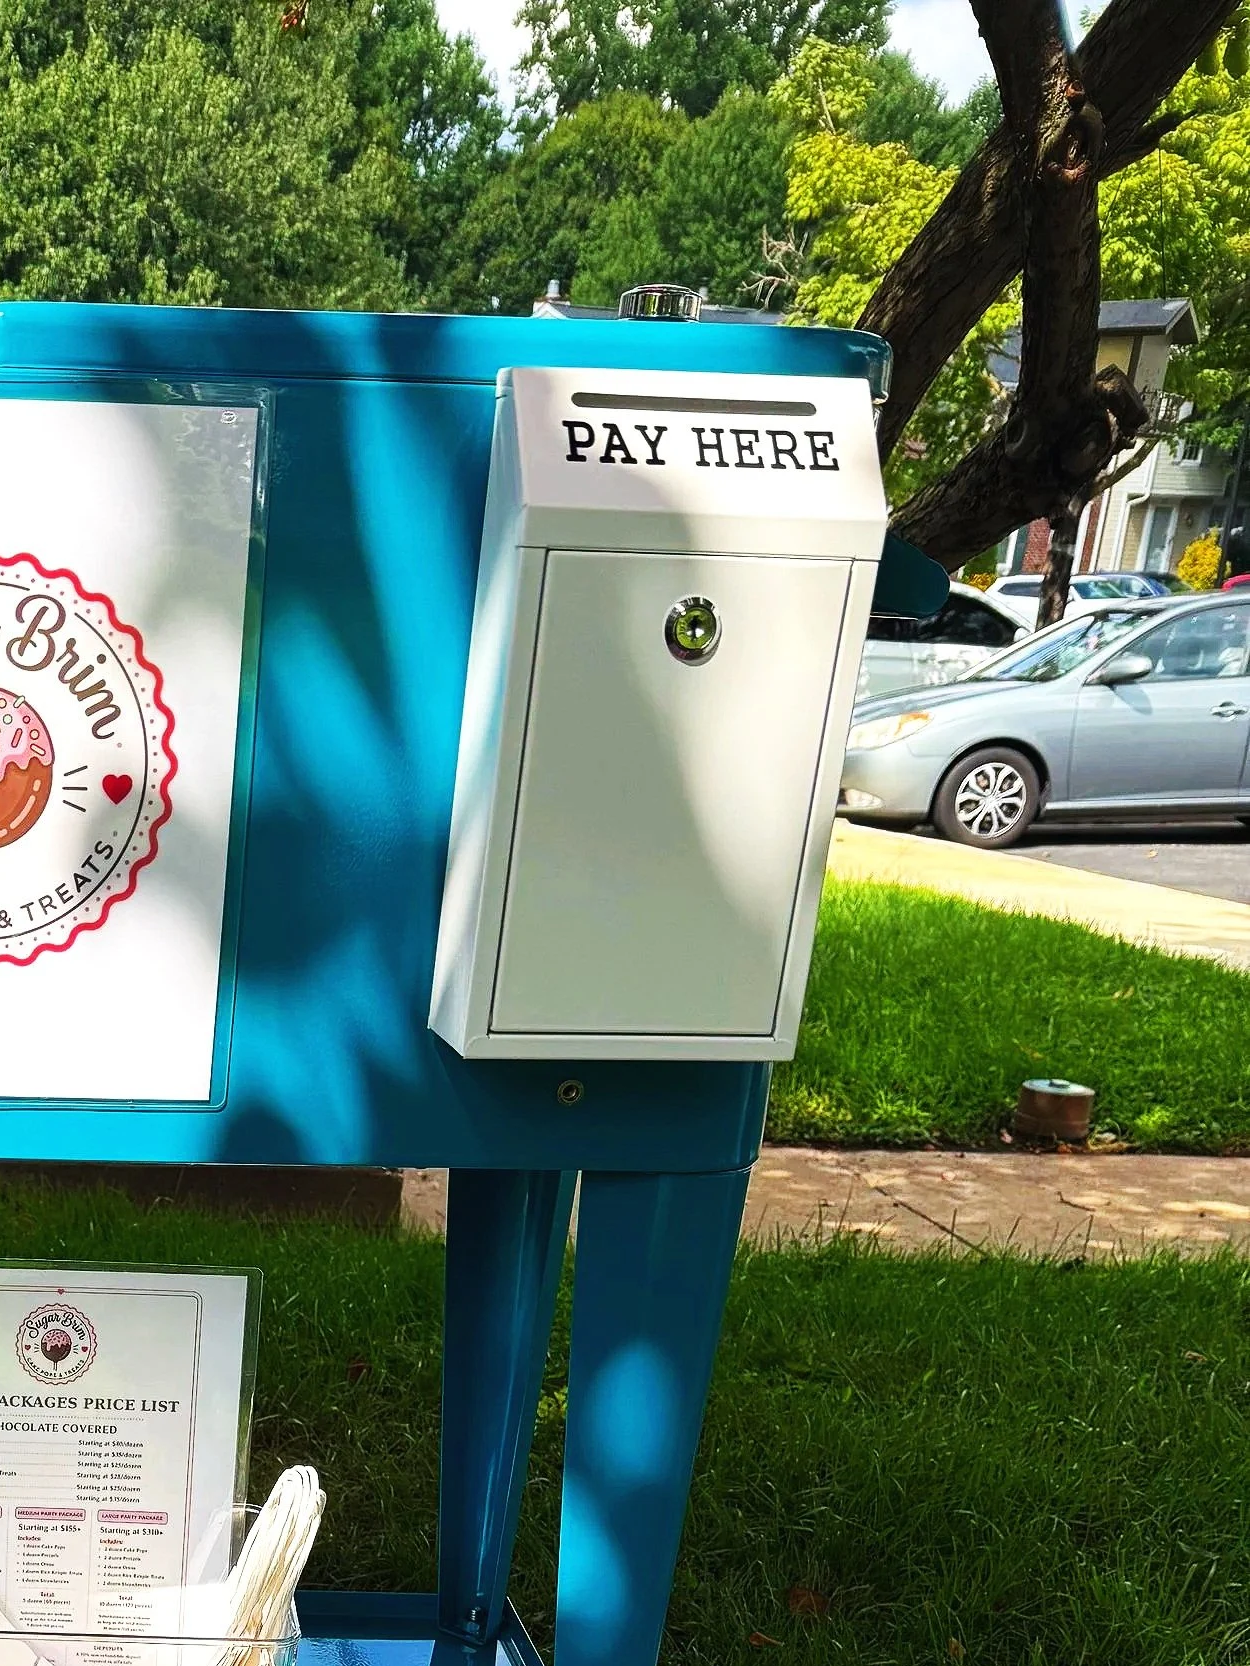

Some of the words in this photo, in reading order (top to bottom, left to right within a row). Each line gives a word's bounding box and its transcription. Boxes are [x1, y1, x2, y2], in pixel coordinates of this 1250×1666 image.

[562, 421, 668, 466] PAY
[692, 426, 840, 472] HERE
[6, 594, 119, 741] Brim
[19, 839, 114, 918] TREATS
[26, 1312, 61, 1338] Sugar
[61, 1312, 86, 1340] Brim
[84, 1398, 136, 1411] PRICE
[141, 1399, 180, 1412] LIST
[62, 1423, 118, 1434] COVERED
[18, 1524, 48, 1532] Starting
[100, 1527, 130, 1536] Starting
